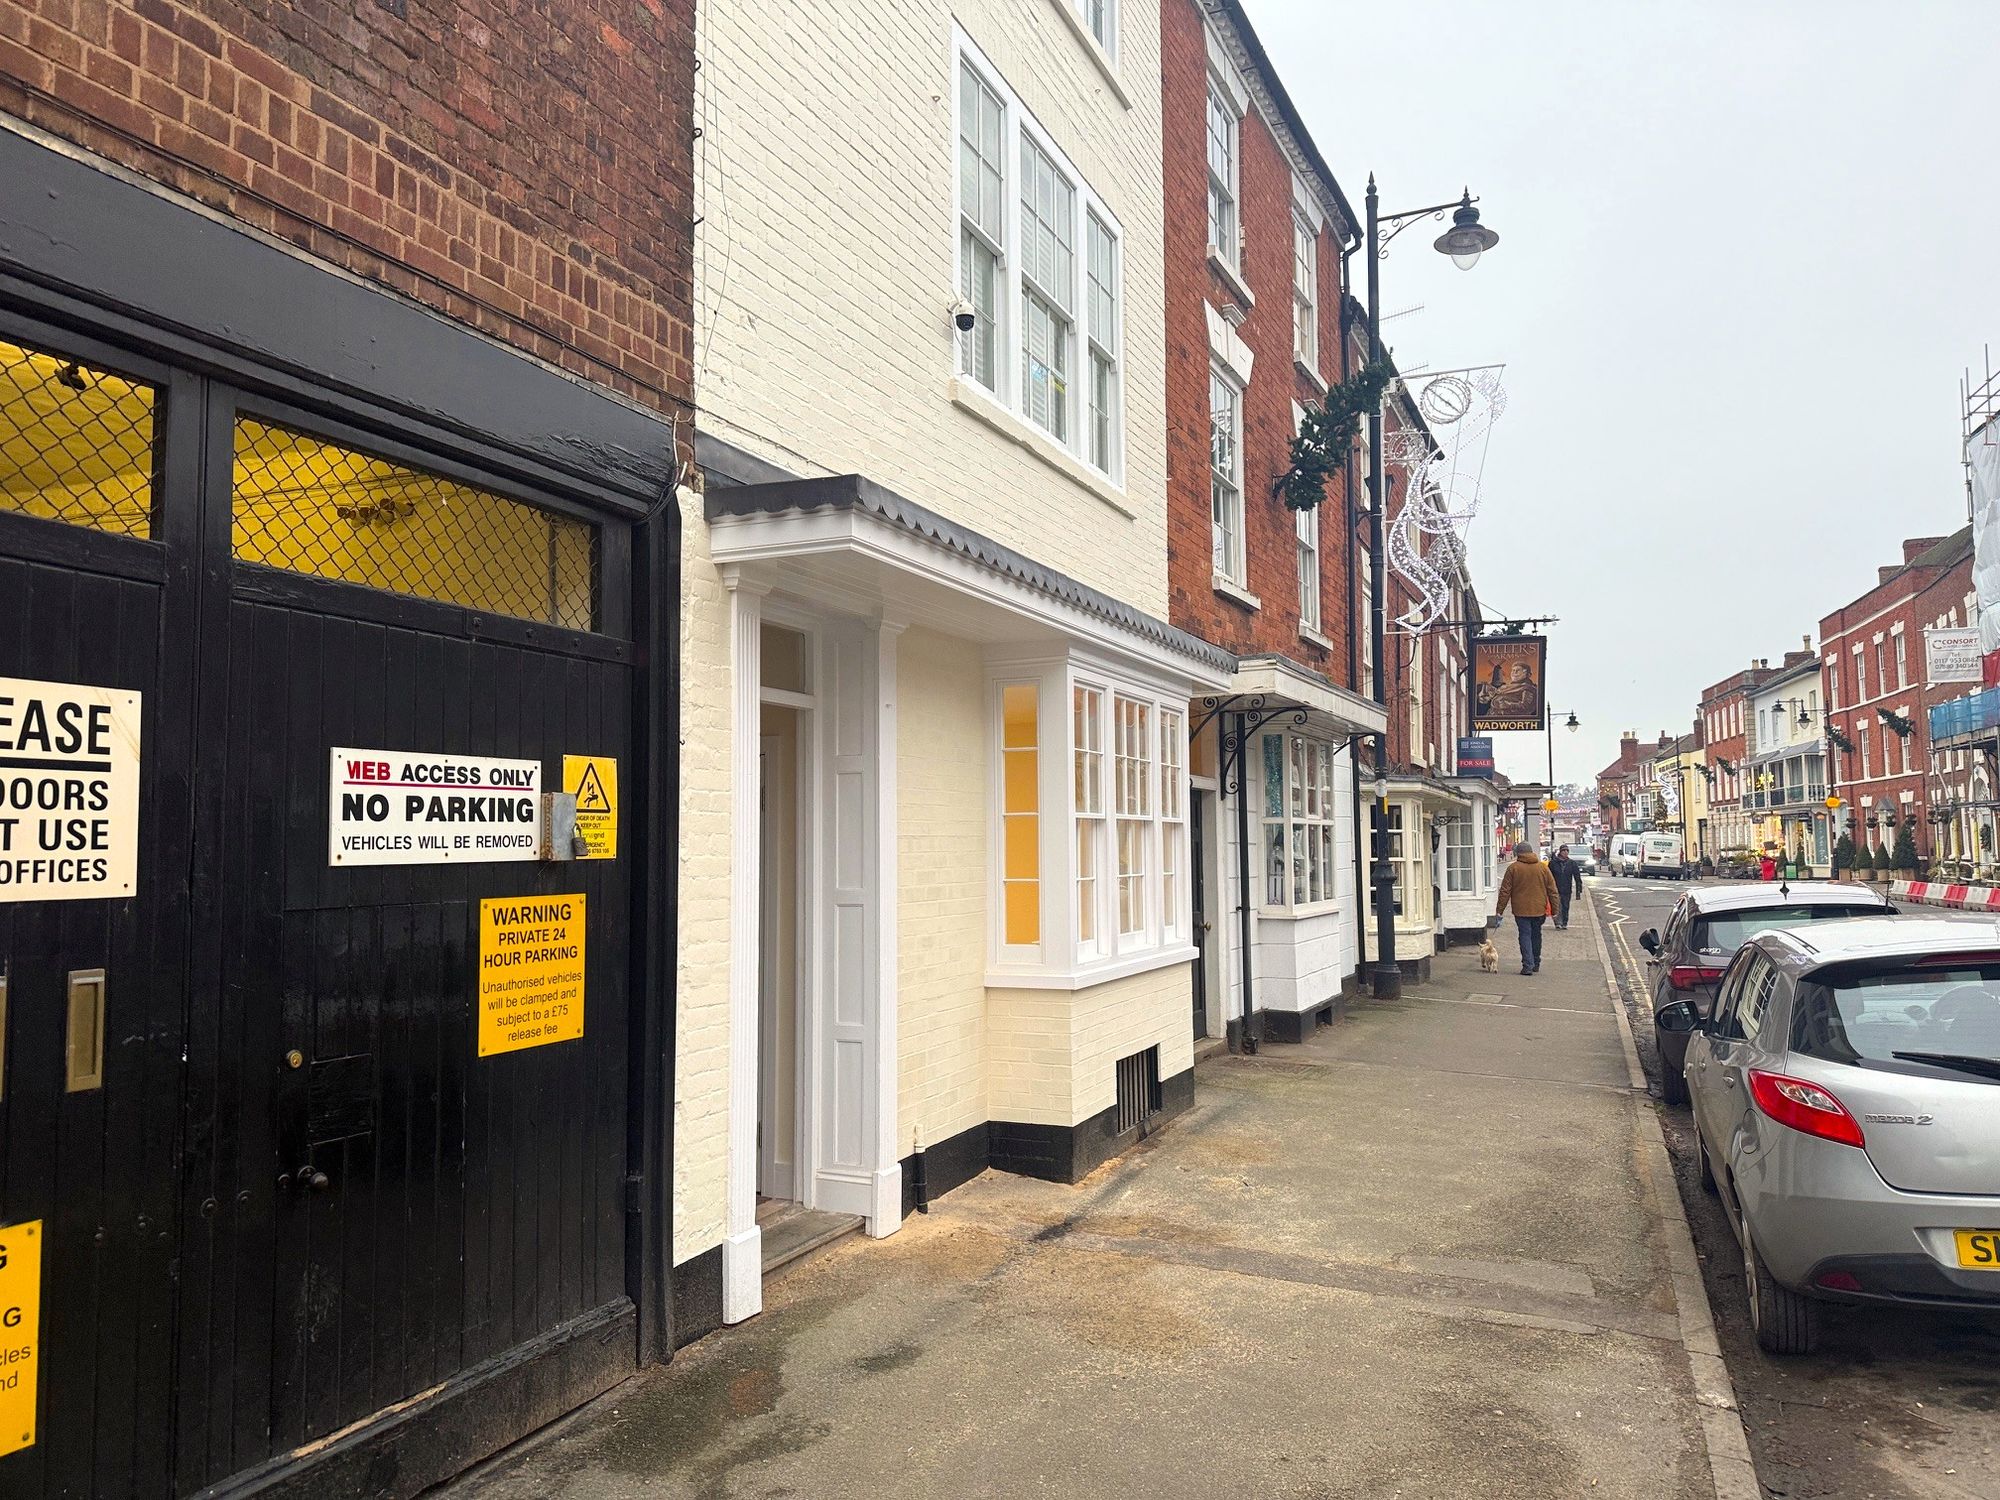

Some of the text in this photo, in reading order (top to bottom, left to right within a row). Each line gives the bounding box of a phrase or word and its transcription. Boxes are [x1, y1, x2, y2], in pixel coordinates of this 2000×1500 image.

[1474, 721, 1538, 730] WADWORTH
[400, 763, 481, 784] ACCESS
[490, 768, 534, 786] ONLY
[0, 777, 109, 811] OORS
[342, 793, 534, 823] NO PARKING
[38, 818, 109, 851] USE
[342, 835, 533, 851] VEHICLES WILL BE REMOVED
[492, 903, 572, 926] WARNING
[498, 927, 566, 946] PRIVATE 24
[484, 945, 578, 968] HOUR PARKING
[482, 970, 582, 994] Unauthorised vehicles
[488, 987, 577, 1011] will be clamped and
[497, 1004, 568, 1028] subject to a £75
[508, 1023, 558, 1042] release fee
[1970, 1235, 2000, 1262] S
